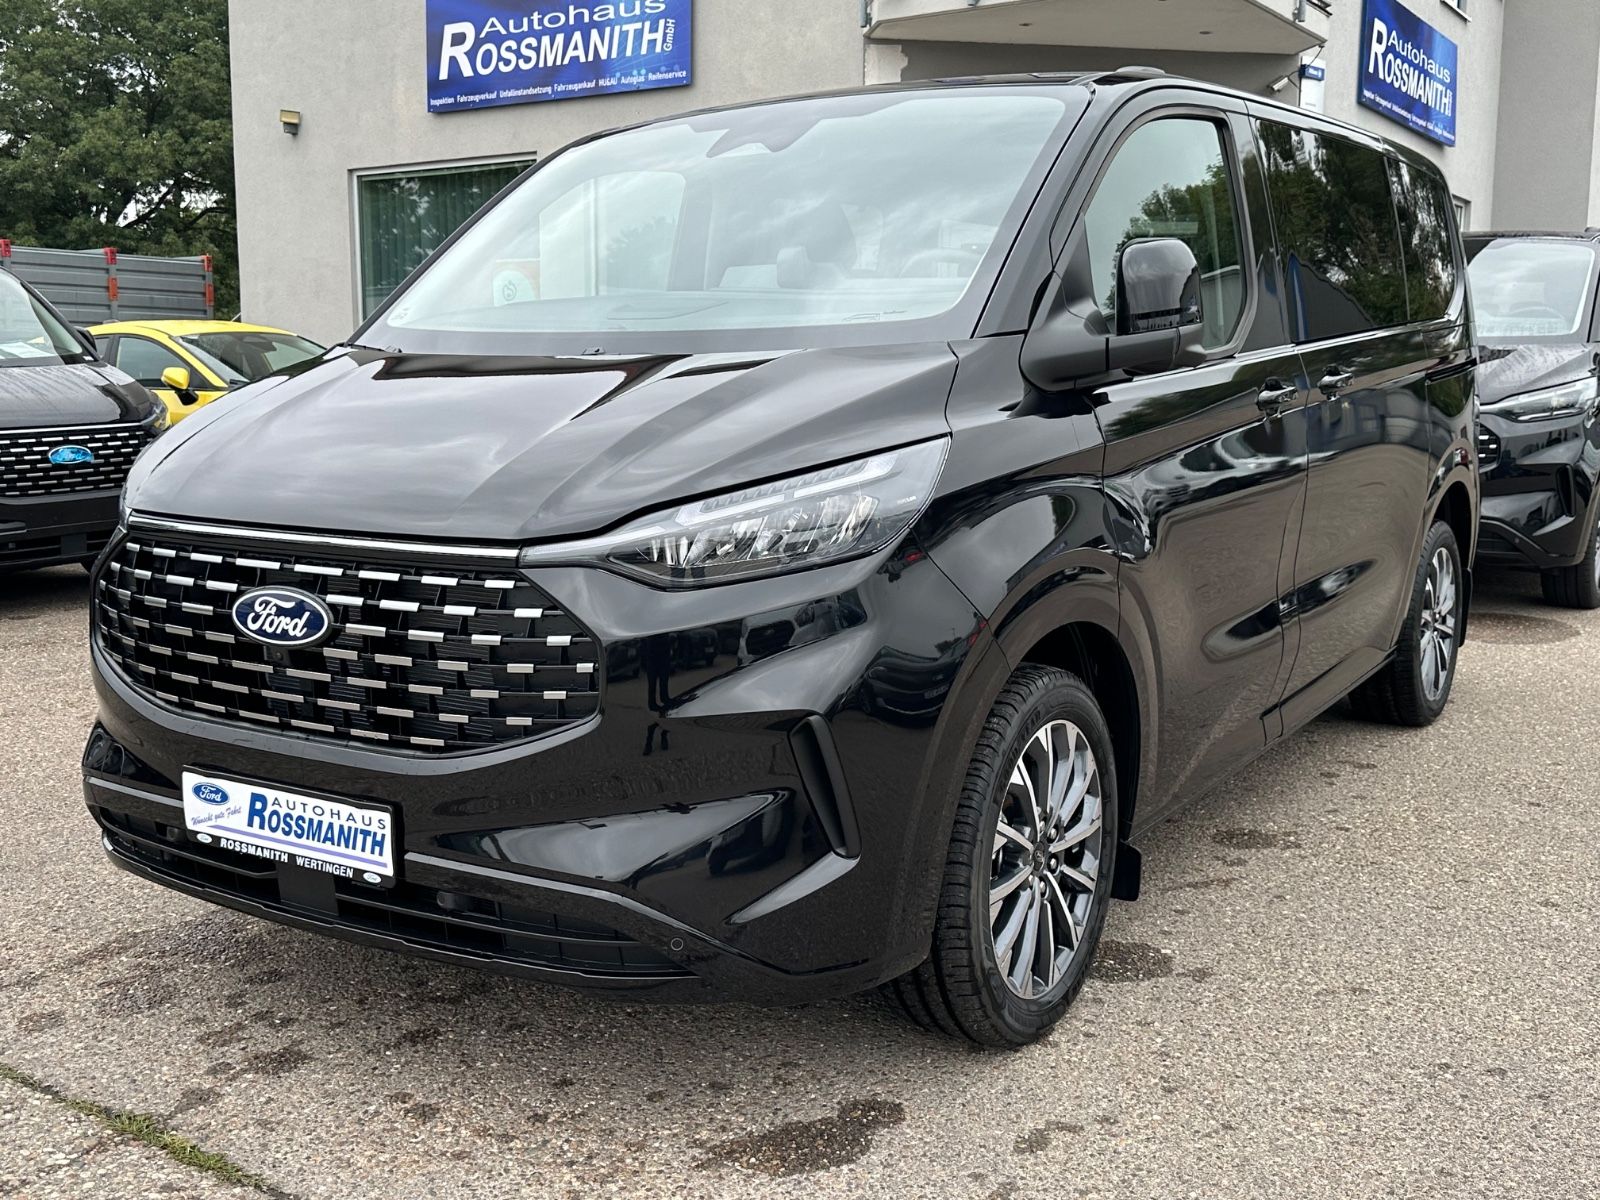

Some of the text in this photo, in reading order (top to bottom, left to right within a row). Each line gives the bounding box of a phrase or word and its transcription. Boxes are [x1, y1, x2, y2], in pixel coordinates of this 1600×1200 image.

[480, 0, 665, 38] Autohaus
[663, 19, 676, 51] GmbH
[438, 19, 665, 80] ROSSMANITH
[1368, 17, 1451, 116] ROSSMANITH
[1387, 29, 1451, 83] Autohaus
[457, 91, 497, 103] Fahrzeugverkauf
[554, 79, 596, 92] Fahrzeugankauf
[621, 74, 645, 85] Autoglas
[648, 69, 687, 81] Reifenservice
[246, 596, 310, 637] Ford
[199, 785, 222, 802] Ford
[271, 796, 386, 830] AUTOHAUS
[247, 792, 386, 857] ROSSMANITH
[220, 838, 354, 878] ROSSMANITH WERTINGEN
